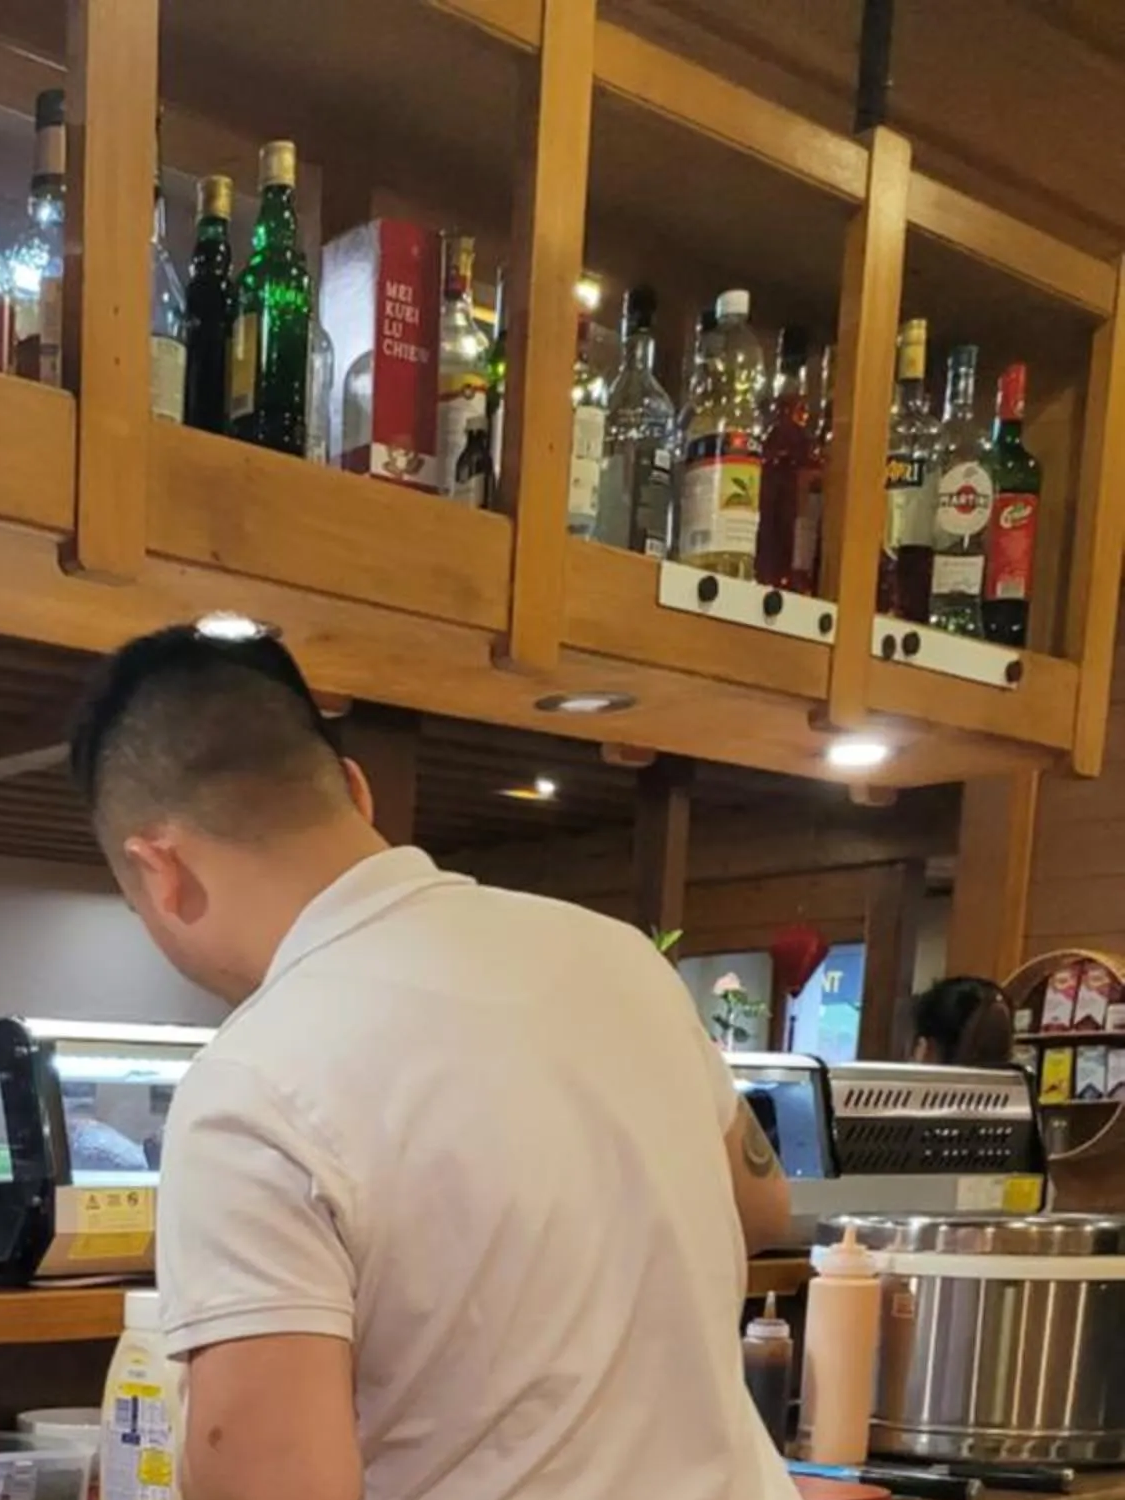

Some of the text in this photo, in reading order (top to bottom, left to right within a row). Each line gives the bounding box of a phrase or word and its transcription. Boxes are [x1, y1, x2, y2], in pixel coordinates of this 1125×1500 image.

[386, 281, 413, 303] MEI
[385, 300, 420, 326] KUEI
[383, 319, 403, 338] LU
